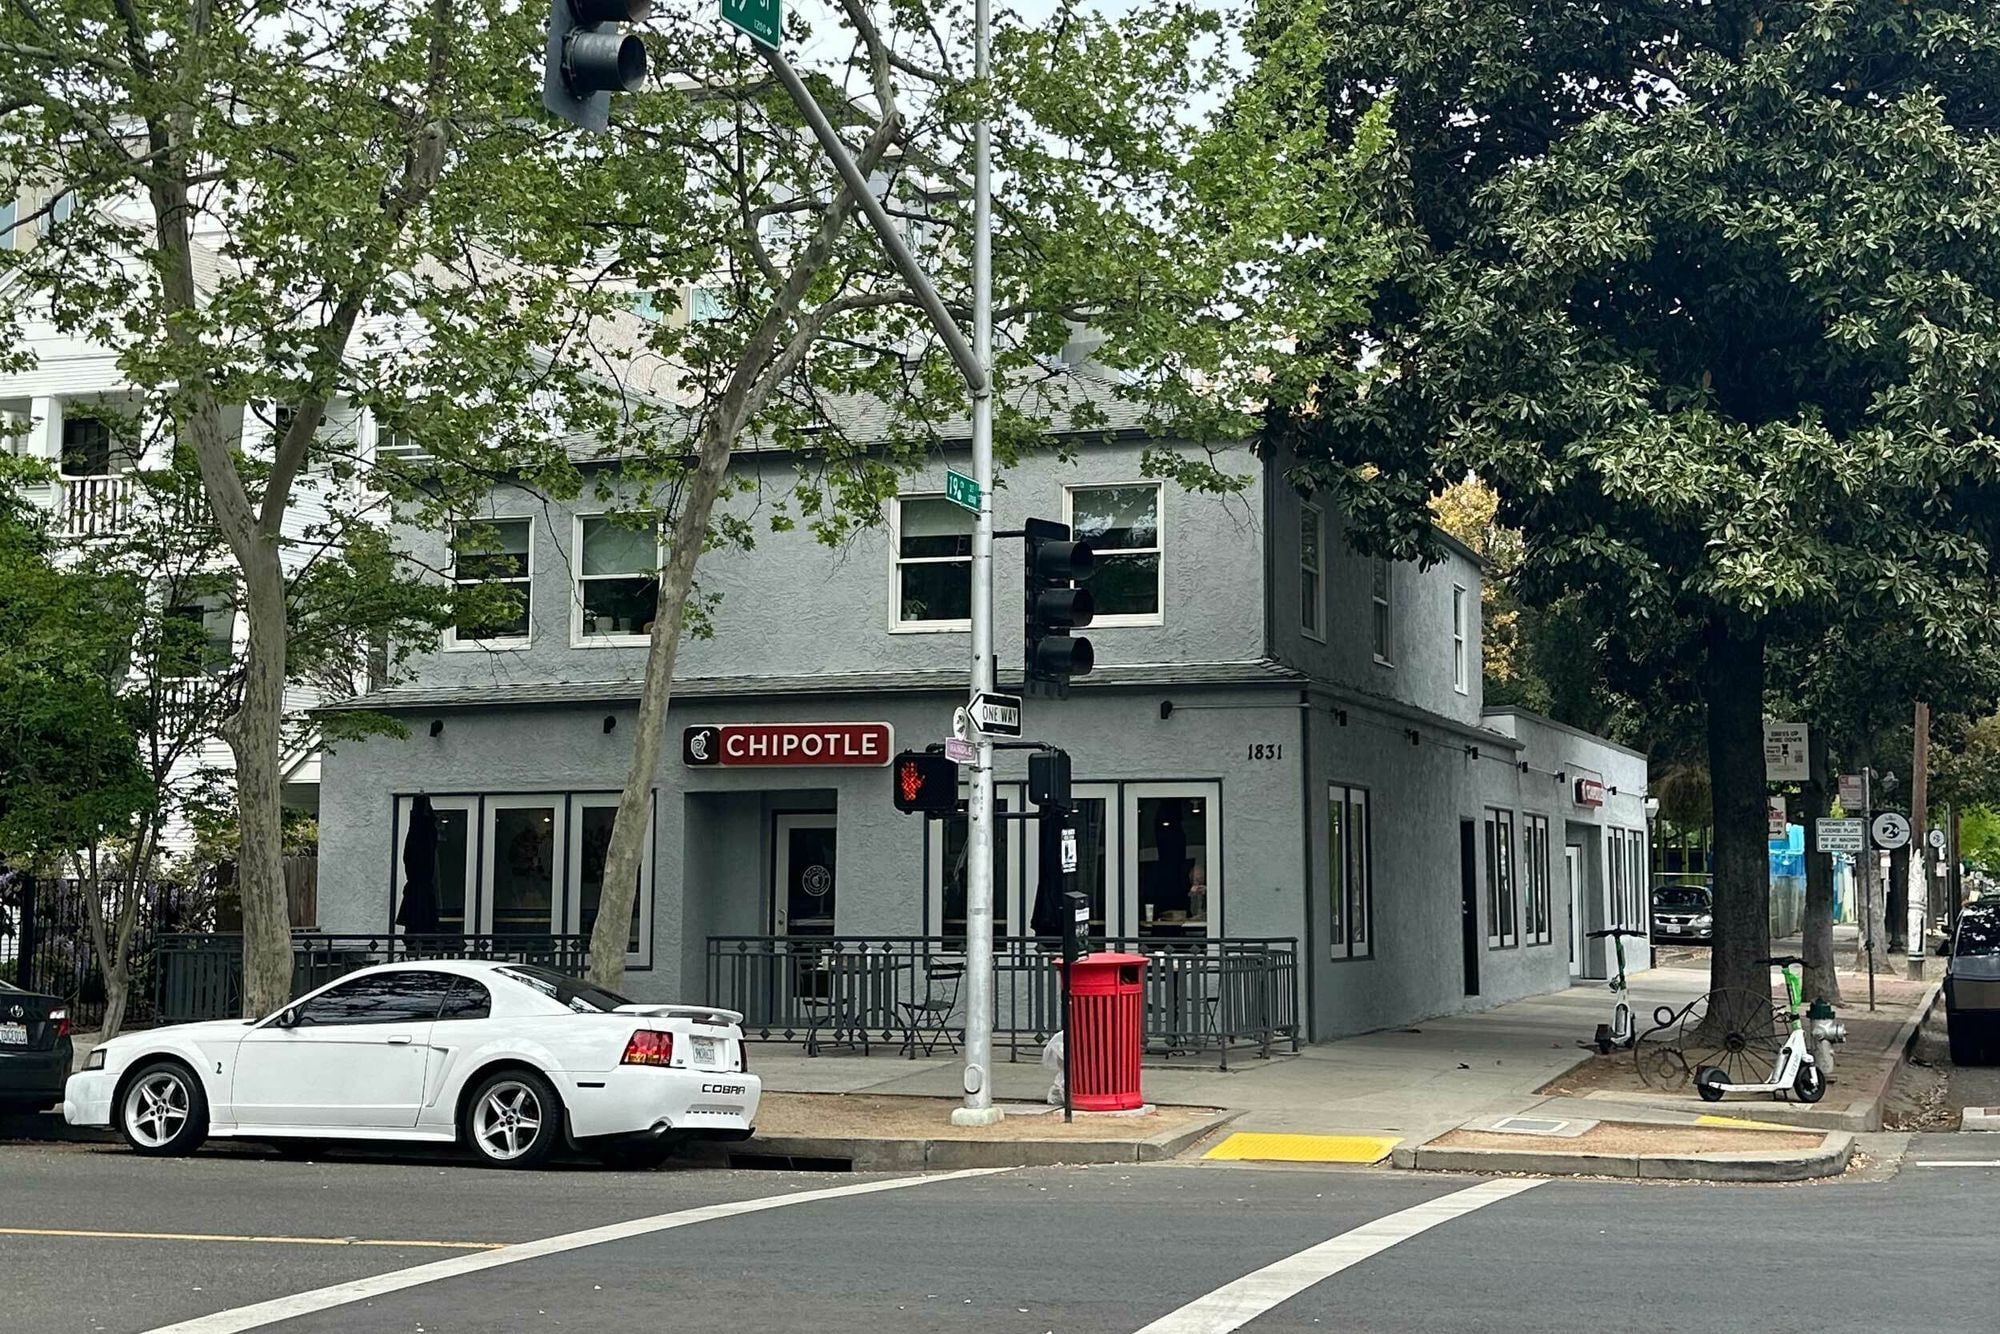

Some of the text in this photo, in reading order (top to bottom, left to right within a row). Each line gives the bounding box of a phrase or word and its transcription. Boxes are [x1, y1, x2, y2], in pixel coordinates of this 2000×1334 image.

[982, 705, 1017, 725] ONE WAY
[726, 732, 879, 758] CHIPOTLE
[1247, 743, 1282, 761] 1831
[701, 1083, 746, 1095] COBRA
